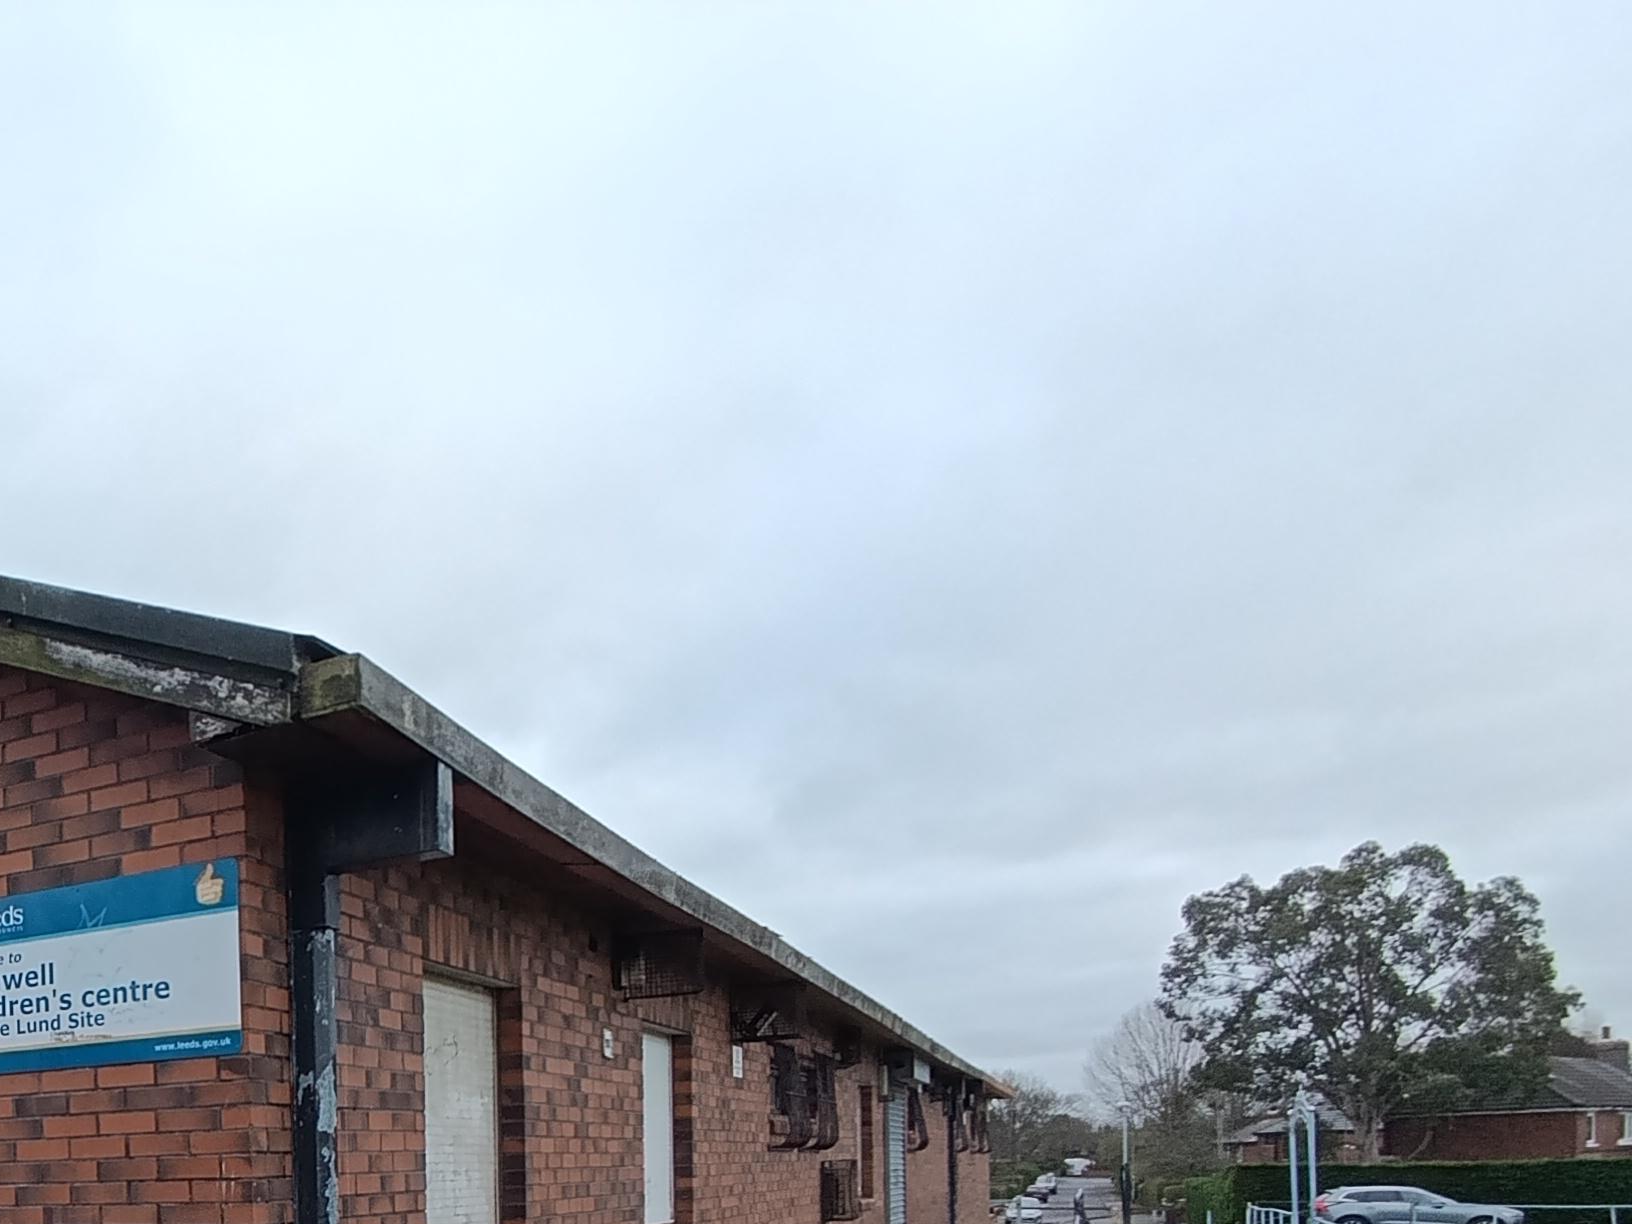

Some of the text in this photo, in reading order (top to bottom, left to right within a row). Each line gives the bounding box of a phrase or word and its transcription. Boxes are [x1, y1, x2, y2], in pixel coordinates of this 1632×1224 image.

[9, 953, 22, 964] to
[82, 980, 171, 1008] centre
[17, 1014, 61, 1035] Lund
[69, 1012, 105, 1029] Site
[154, 1036, 231, 1051] www.leeds.gov.uk
